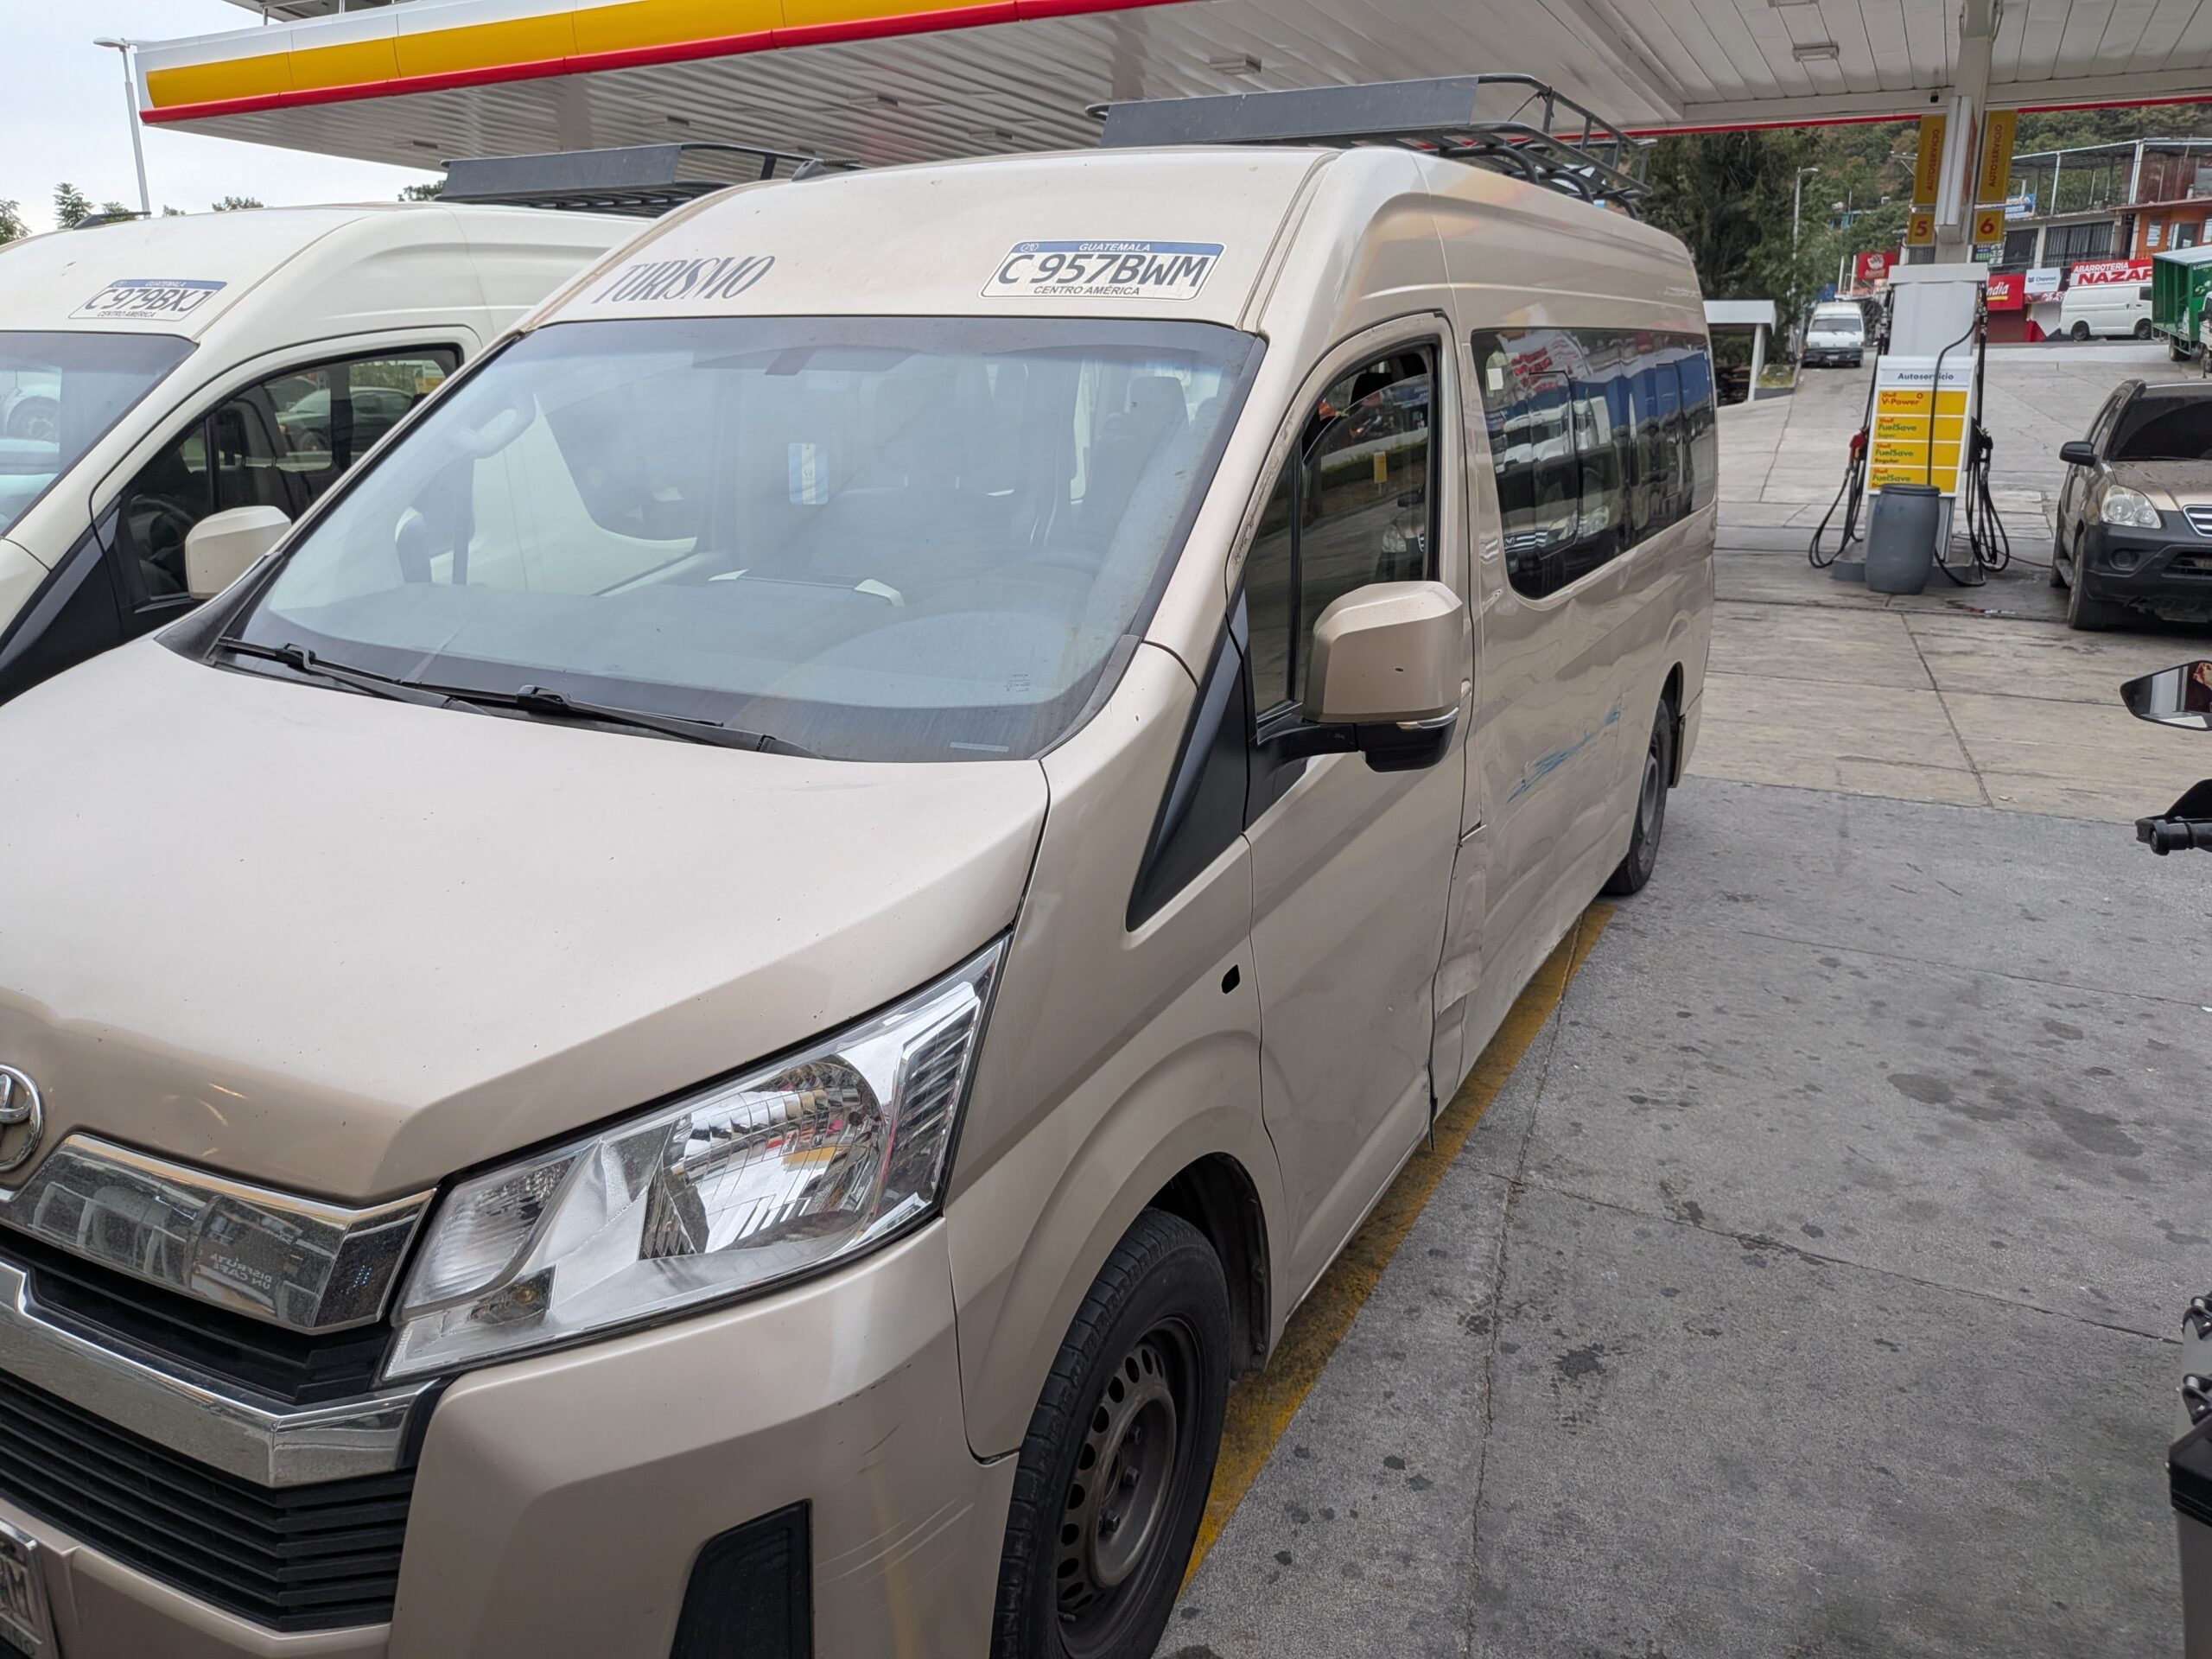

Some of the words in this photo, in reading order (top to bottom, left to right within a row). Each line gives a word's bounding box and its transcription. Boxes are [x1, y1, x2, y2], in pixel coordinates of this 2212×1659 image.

[1926, 129, 1940, 191] AUTOSERVICIO
[1989, 124, 2002, 188] AUTOSERVICIO
[1915, 220, 1928, 237] 5
[1980, 218, 1994, 235] 6
[1078, 243, 1150, 252] GUATEMALA
[2074, 261, 2129, 273] ABARROTERIA
[591, 256, 775, 304] TURISMO
[1033, 286, 1083, 295] CENTRO
[1084, 285, 1140, 296] AMÉRICA
[1872, 474, 1911, 482] FuelSave
